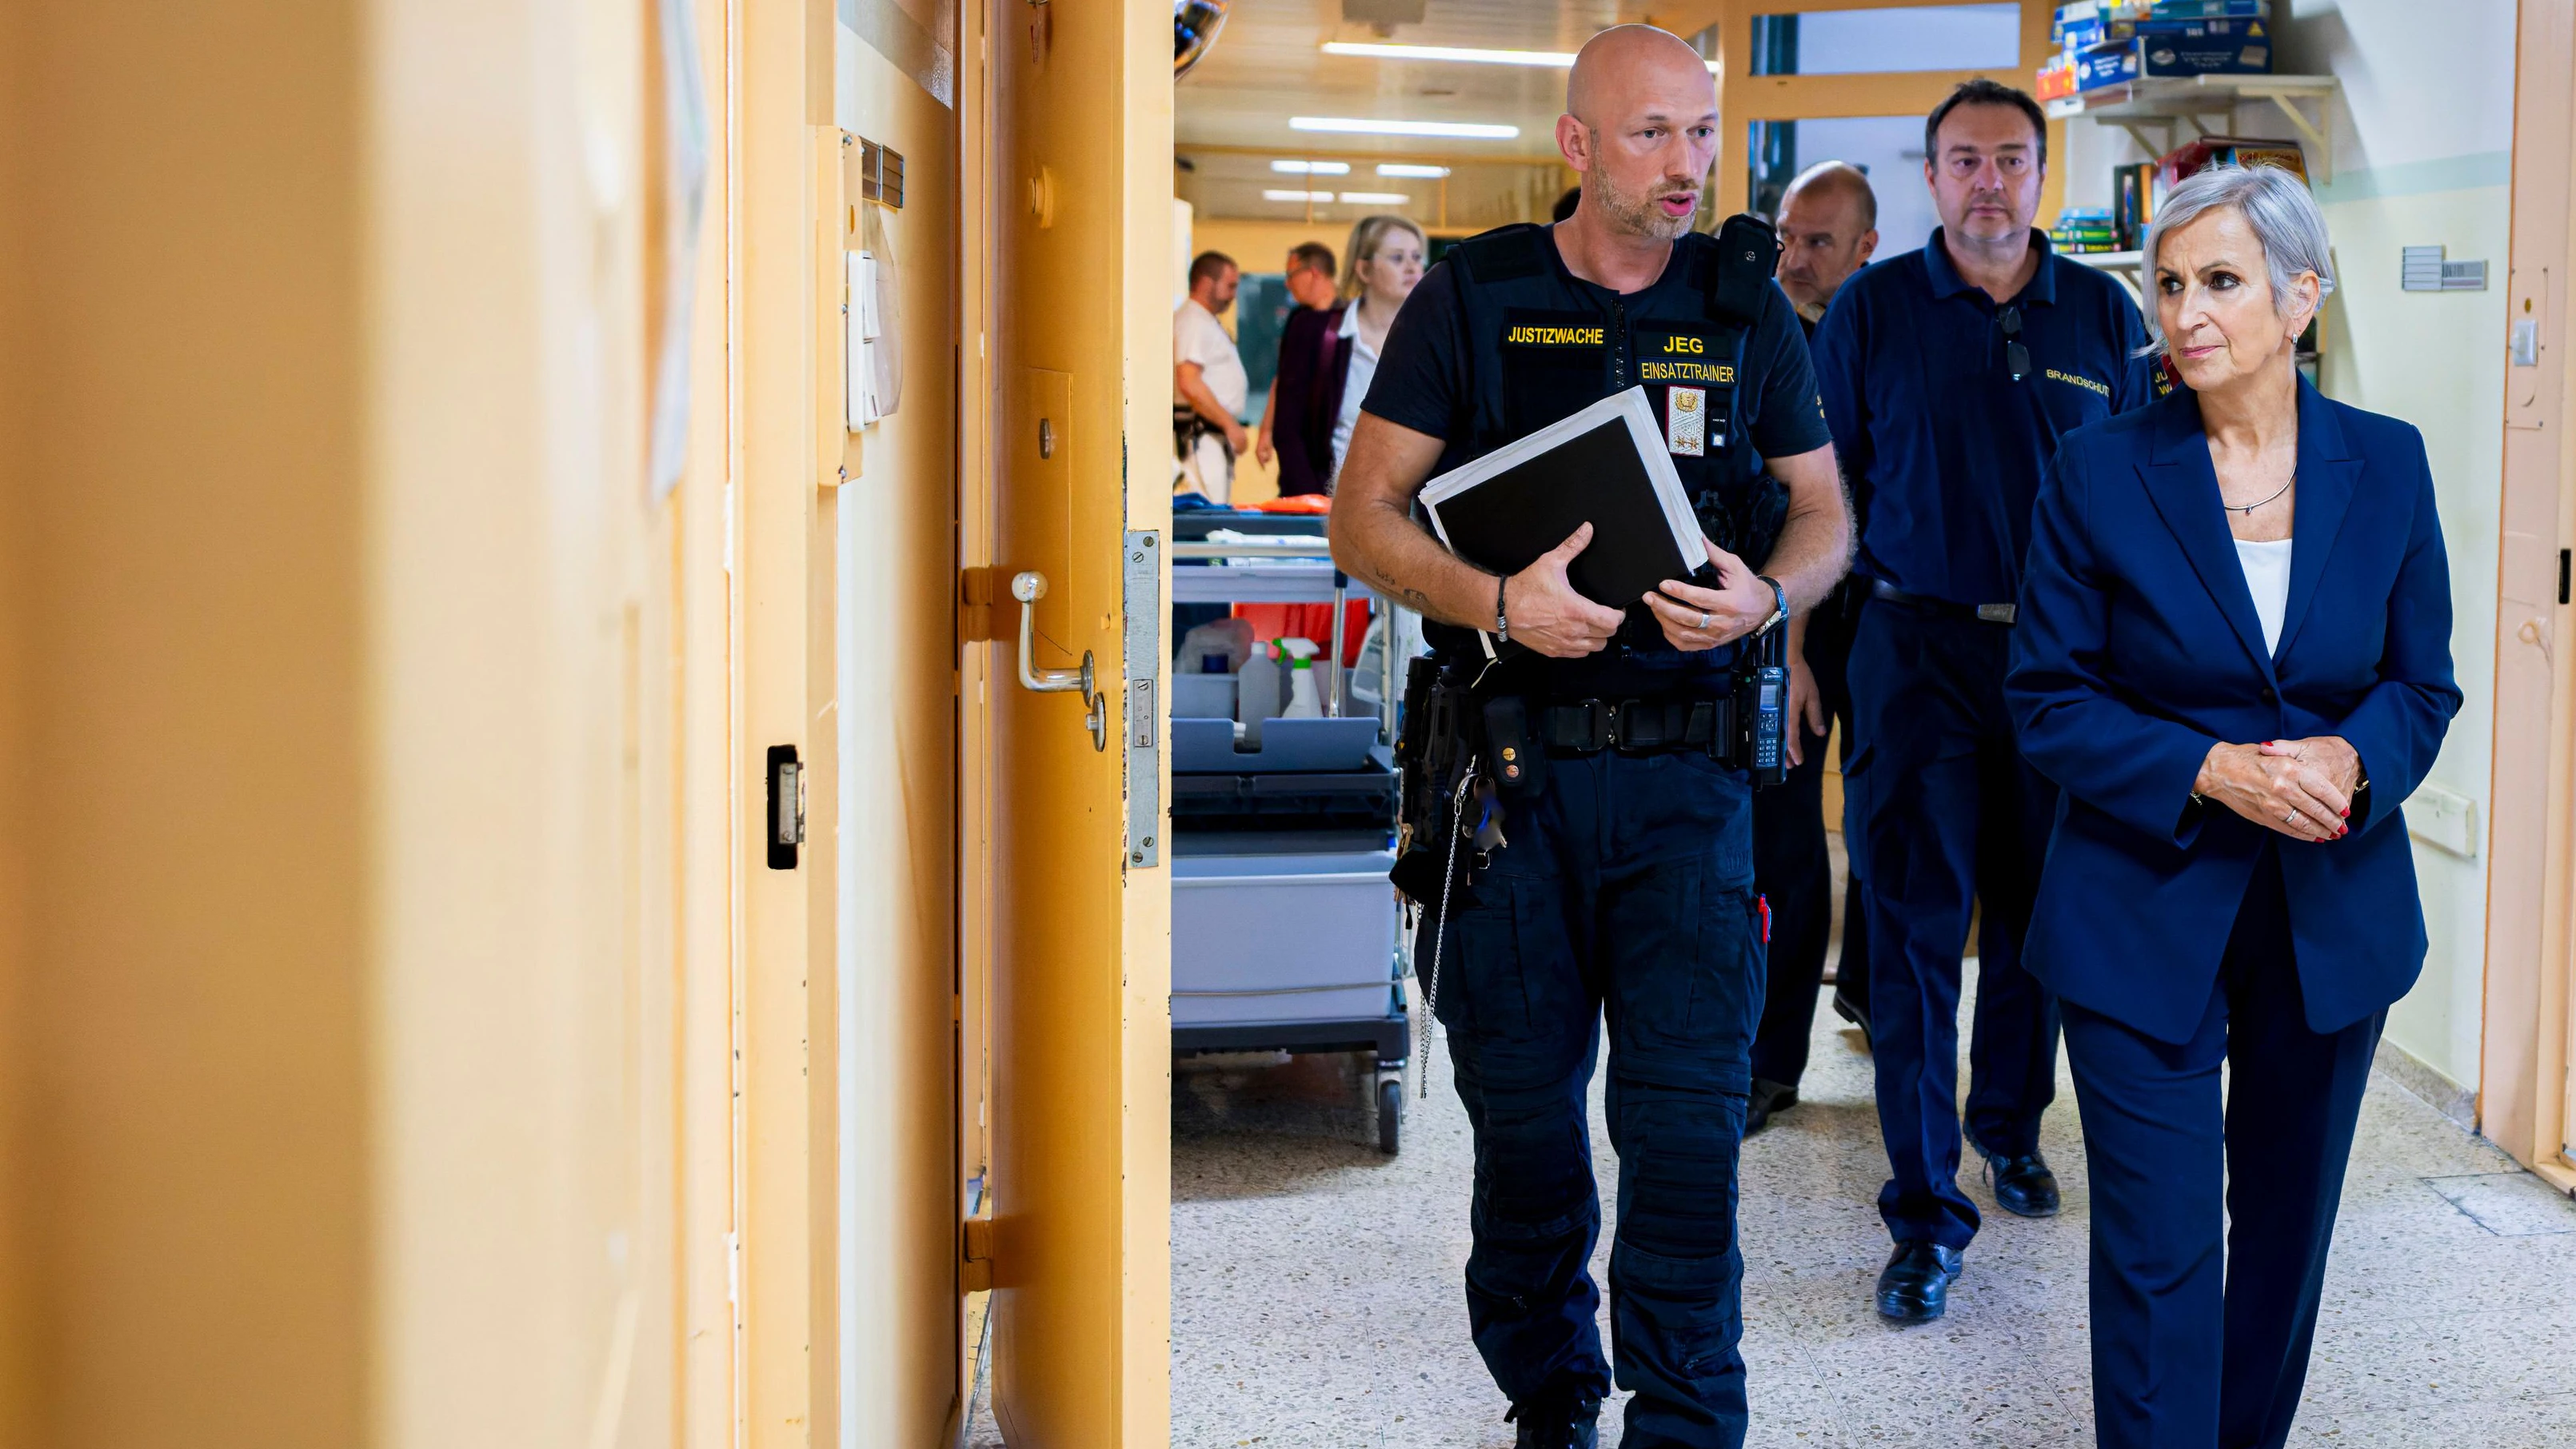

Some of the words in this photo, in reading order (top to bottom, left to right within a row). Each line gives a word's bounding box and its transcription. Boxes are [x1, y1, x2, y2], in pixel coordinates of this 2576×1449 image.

[1508, 326, 1604, 345] JUSTIZWACHE
[1663, 336, 1704, 353] JEG
[1641, 362, 1735, 383] EINSATZTRAINER
